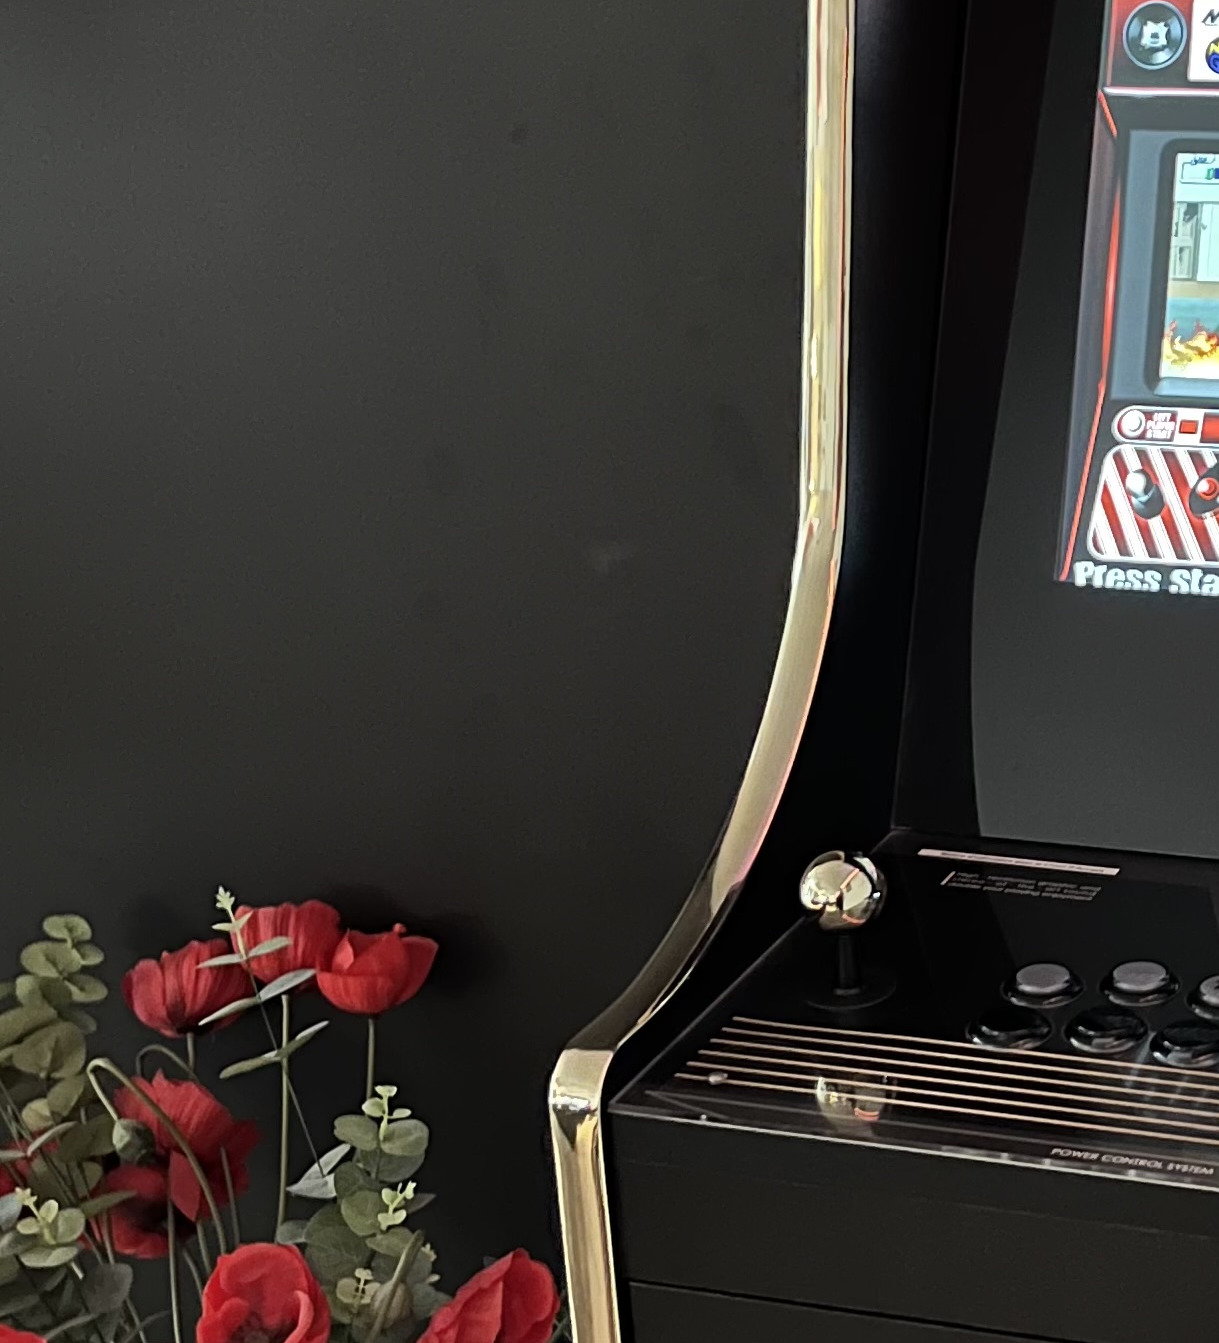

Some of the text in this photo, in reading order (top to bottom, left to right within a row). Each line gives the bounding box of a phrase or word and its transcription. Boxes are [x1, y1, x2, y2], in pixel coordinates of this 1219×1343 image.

[1074, 560, 1161, 592] Press
[1050, 1147, 1215, 1176] POWER CONTROL SYSTEM
